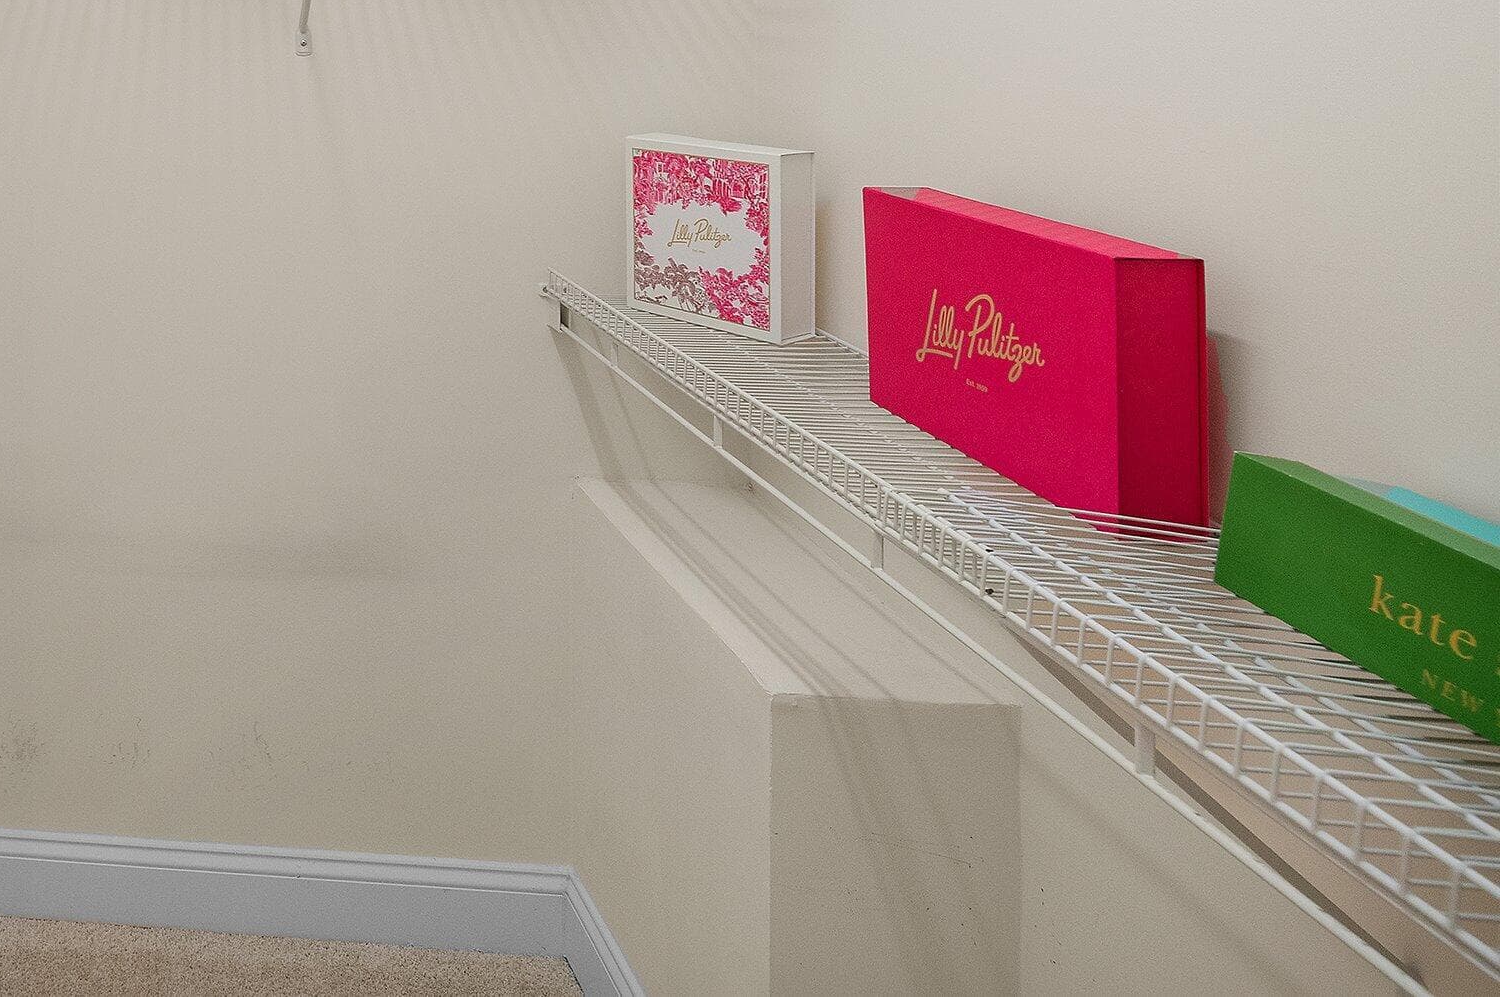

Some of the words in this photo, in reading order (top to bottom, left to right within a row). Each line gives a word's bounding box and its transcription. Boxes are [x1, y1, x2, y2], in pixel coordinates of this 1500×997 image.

[667, 218, 694, 248] Lilly
[693, 218, 732, 249] Pulitzer
[916, 288, 965, 371] Lilly
[964, 293, 1046, 383] Pulitzer
[1368, 574, 1477, 661] kate
[1421, 668, 1484, 714] NEW
